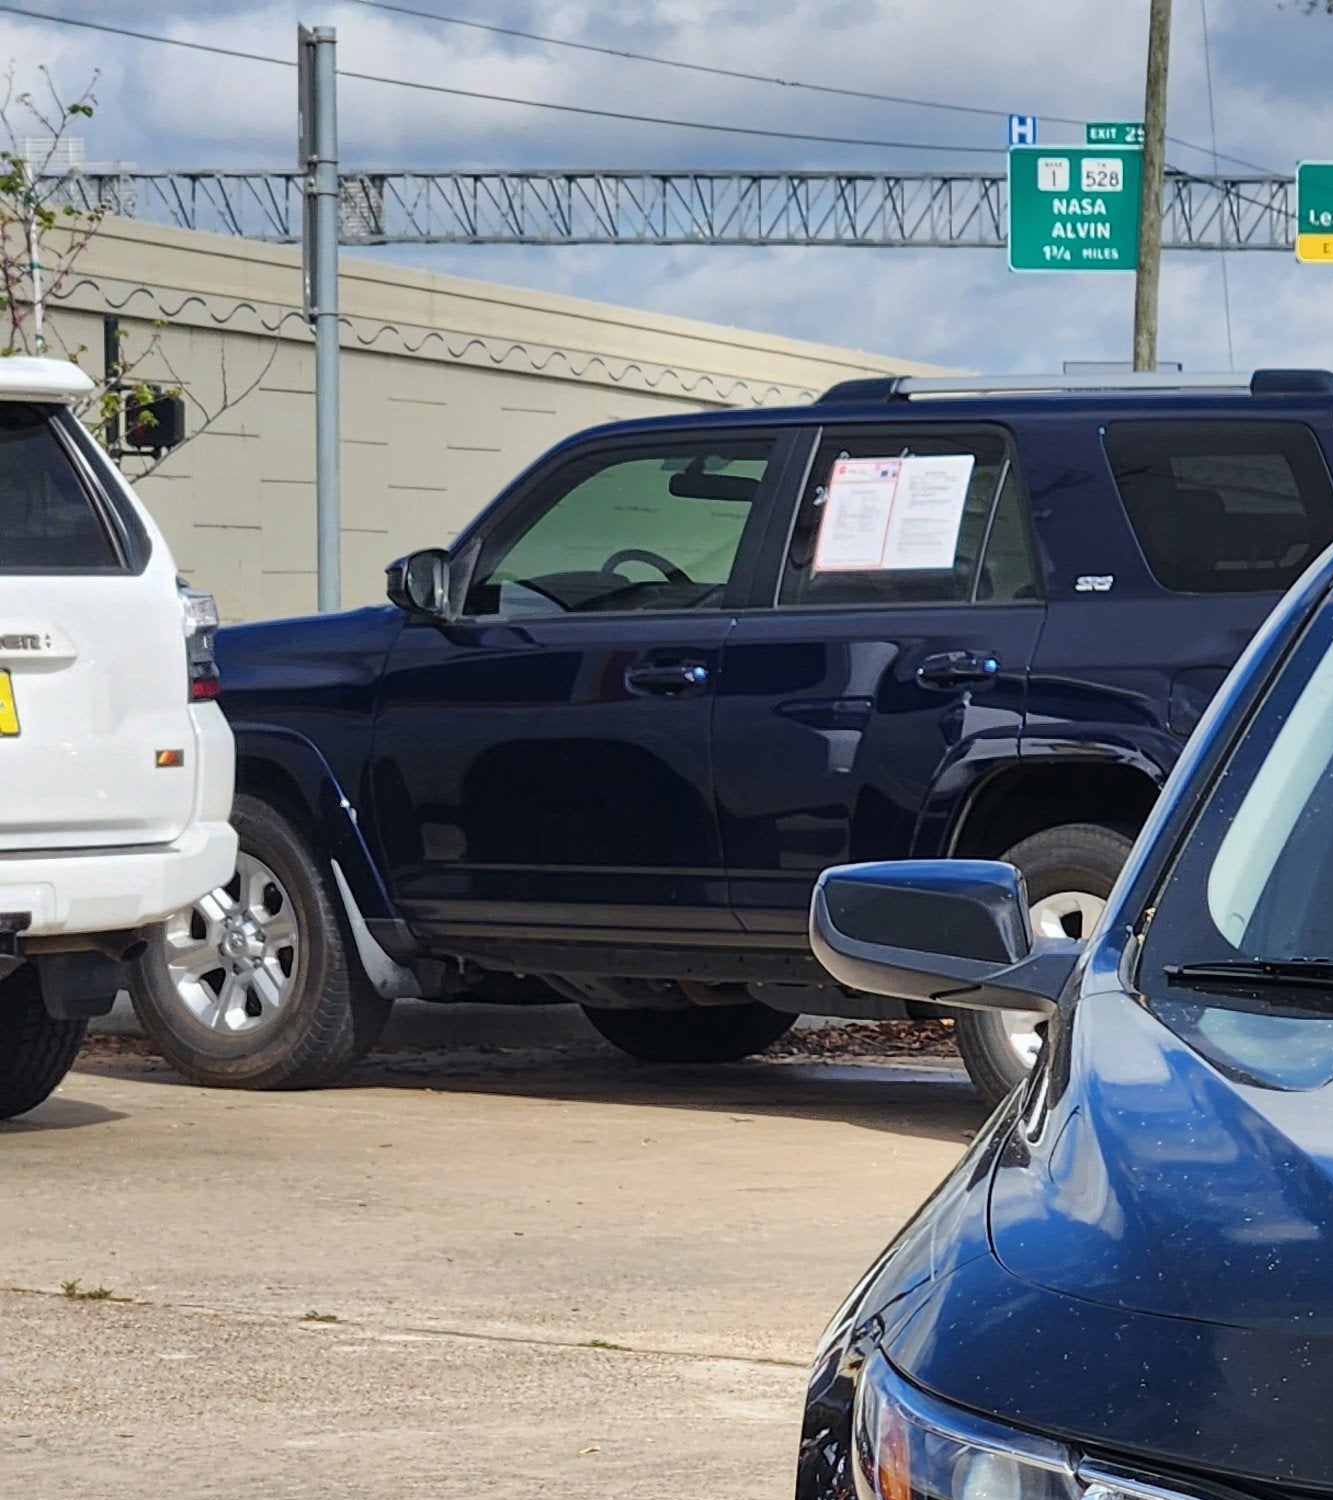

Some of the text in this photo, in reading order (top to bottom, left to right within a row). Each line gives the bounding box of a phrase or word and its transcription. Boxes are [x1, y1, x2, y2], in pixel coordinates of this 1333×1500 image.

[1012, 116, 1033, 144] H
[1090, 127, 1117, 139] EXIT
[1086, 171, 1119, 187] 528
[1052, 198, 1107, 215] NASA
[1051, 222, 1111, 239] ALVIN
[1082, 248, 1119, 260] MILES
